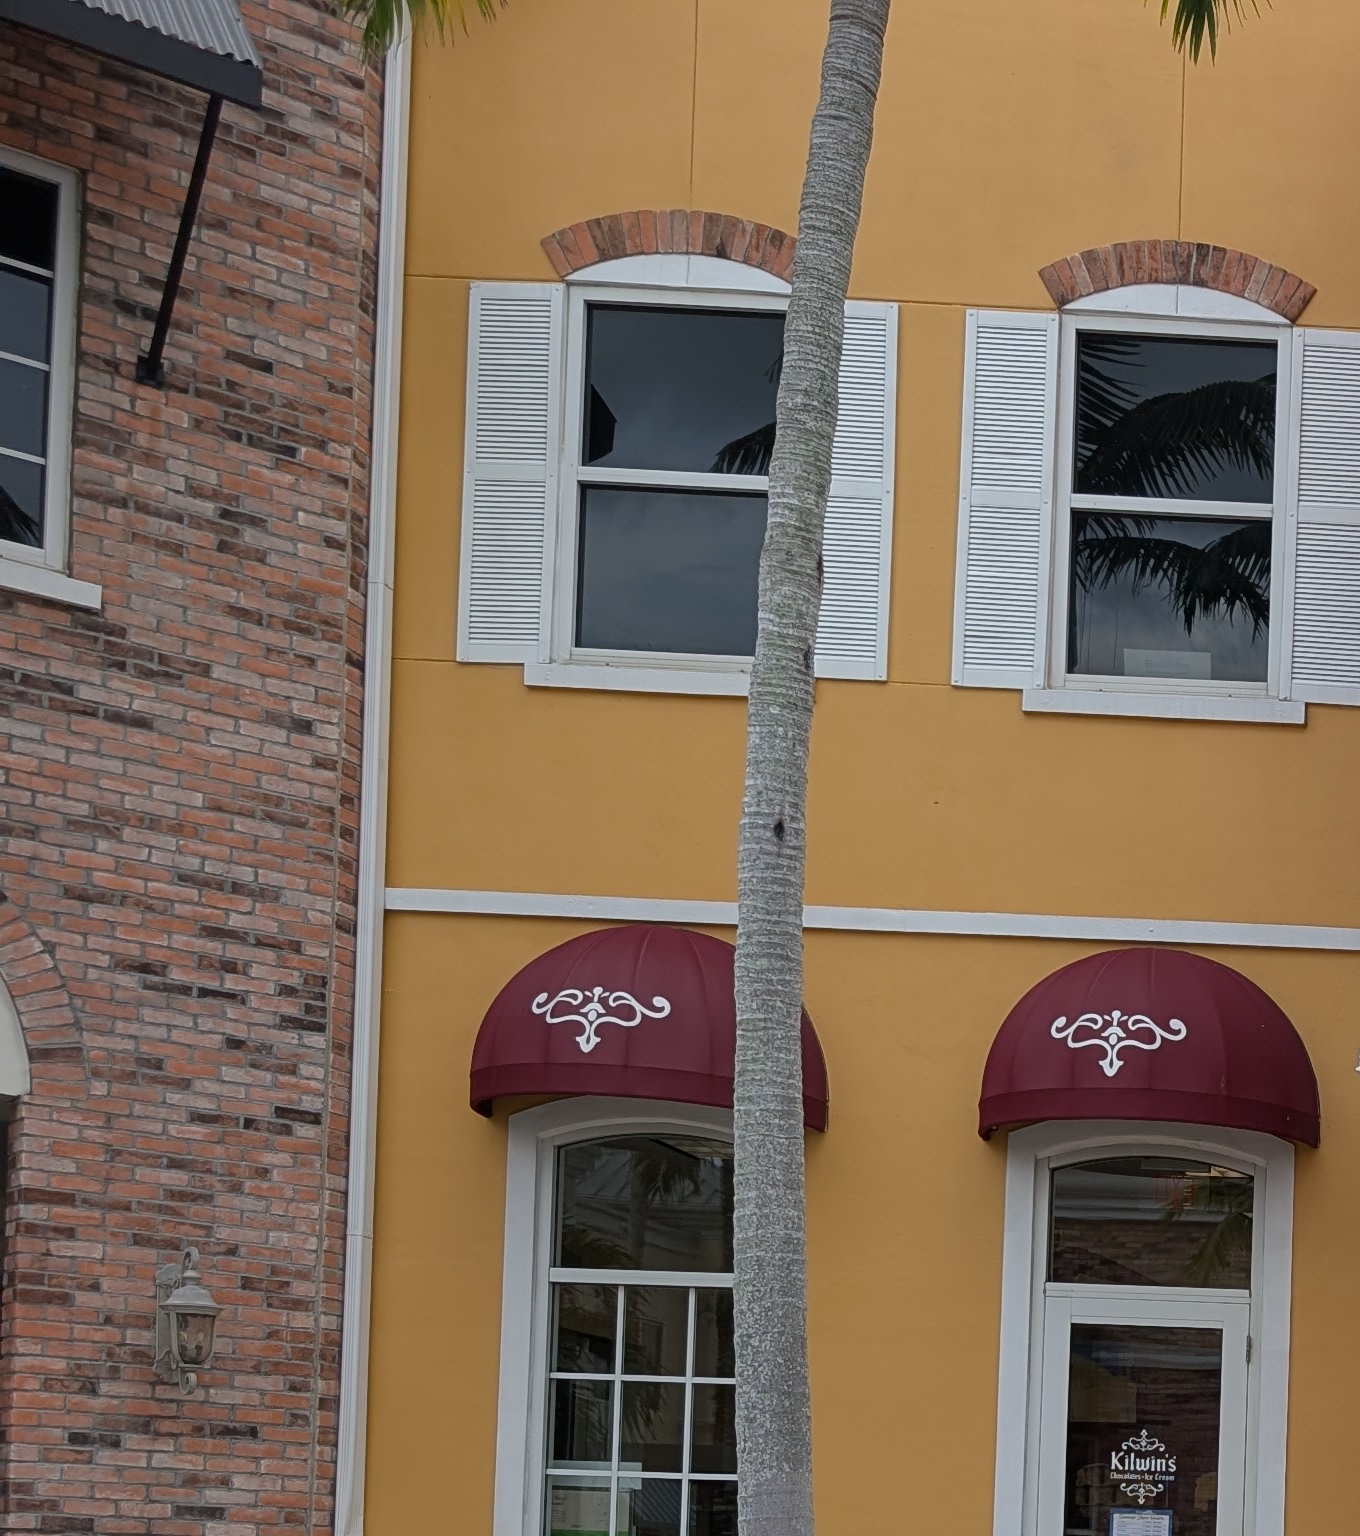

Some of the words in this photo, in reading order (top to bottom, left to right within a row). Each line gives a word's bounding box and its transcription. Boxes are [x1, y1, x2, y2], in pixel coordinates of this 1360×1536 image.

[1110, 1451, 1177, 1472] Kilwin's
[1110, 1472, 1141, 1480] Chocolates
[1155, 1473, 1175, 1481] Cream
